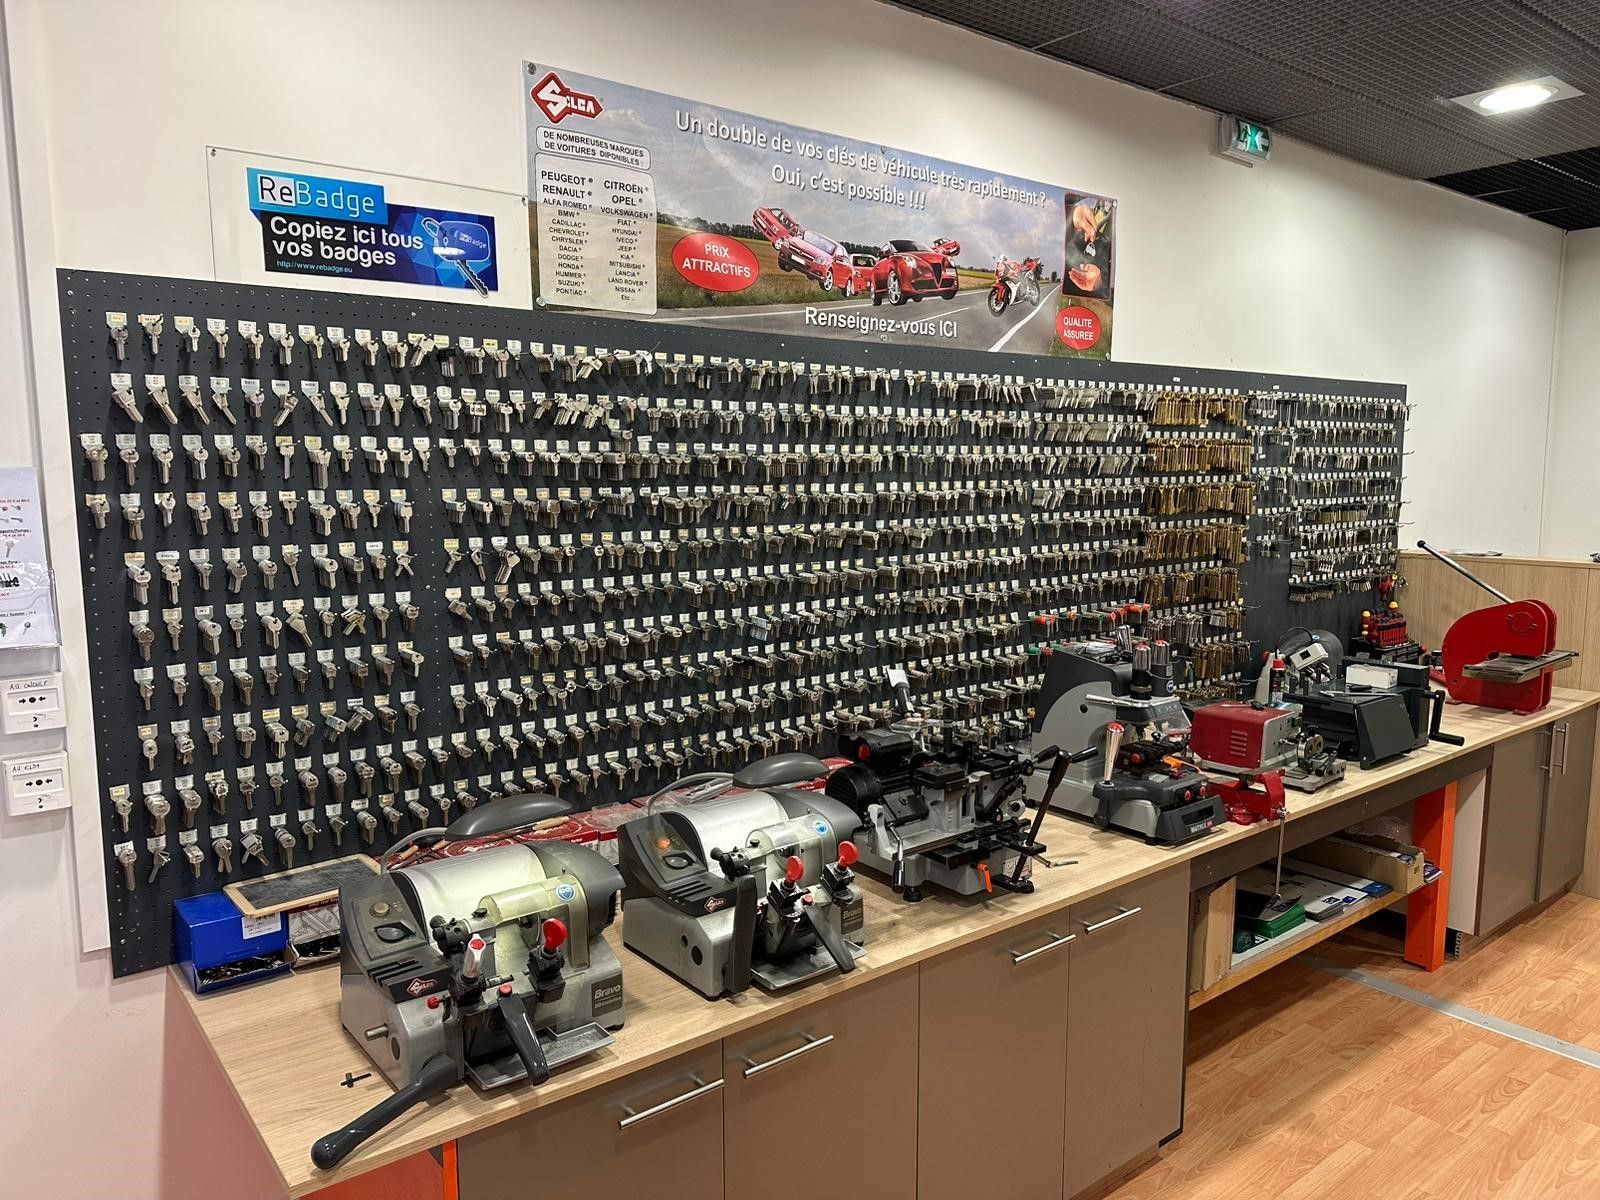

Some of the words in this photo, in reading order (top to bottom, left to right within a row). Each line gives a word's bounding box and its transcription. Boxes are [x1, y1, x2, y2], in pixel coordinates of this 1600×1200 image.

[543, 130, 555, 140] DE
[556, 132, 609, 150] NOMBREUSES
[609, 143, 645, 157] MARQUES
[544, 141, 556, 150] DE
[556, 143, 597, 156] VOITURES
[599, 150, 640, 166] DIPONIBLES
[676, 110, 703, 134] Un
[708, 118, 768, 149] double
[771, 131, 793, 154] de
[796, 141, 824, 161] vos
[827, 143, 856, 168] clés
[859, 151, 878, 172] de
[880, 157, 938, 184] véhicule
[940, 169, 965, 191] très
[968, 177, 1038, 207] rapidement
[541, 170, 586, 186] PEUGEOT
[542, 184, 585, 199] RENAULT
[771, 164, 806, 190] Oui,
[848, 181, 905, 207] possible
[909, 190, 926, 210] !!!
[259, 175, 375, 218] ReBadge
[611, 195, 636, 206] OPEL
[543, 198, 561, 206] ALFA
[562, 201, 588, 211] ROMEO
[557, 210, 575, 218] BMW
[600, 206, 649, 219] VOLKSWAGEN
[551, 218, 582, 228] CADILLAC
[270, 216, 347, 243] Copiez
[353, 225, 376, 244] ici
[381, 229, 424, 249] tous
[548, 227, 585, 237] CHEVROLET
[611, 228, 638, 236] HYUNDAI
[551, 236, 584, 245] CHRYSLER
[272, 239, 314, 258] vos
[319, 241, 397, 268] badges
[557, 253, 580, 261] DODGE
[704, 243, 730, 259] PRIX
[558, 262, 580, 270] HONDA
[609, 260, 641, 270] MITSUBISHI
[682, 257, 751, 278] ATTRACTIFS
[555, 270, 583, 279] HUMMER
[558, 279, 581, 287] SUZUKI
[608, 277, 624, 285] LAND
[624, 279, 644, 287] ROVER
[555, 287, 583, 296] PONTIAC
[614, 286, 636, 294] NISSAN
[805, 306, 936, 336] Renseignez-vous
[939, 320, 958, 338] ICI
[1063, 316, 1093, 328] QUALITE
[1063, 329, 1094, 341] ASSUREE
[594, 984, 621, 999] Bravo
